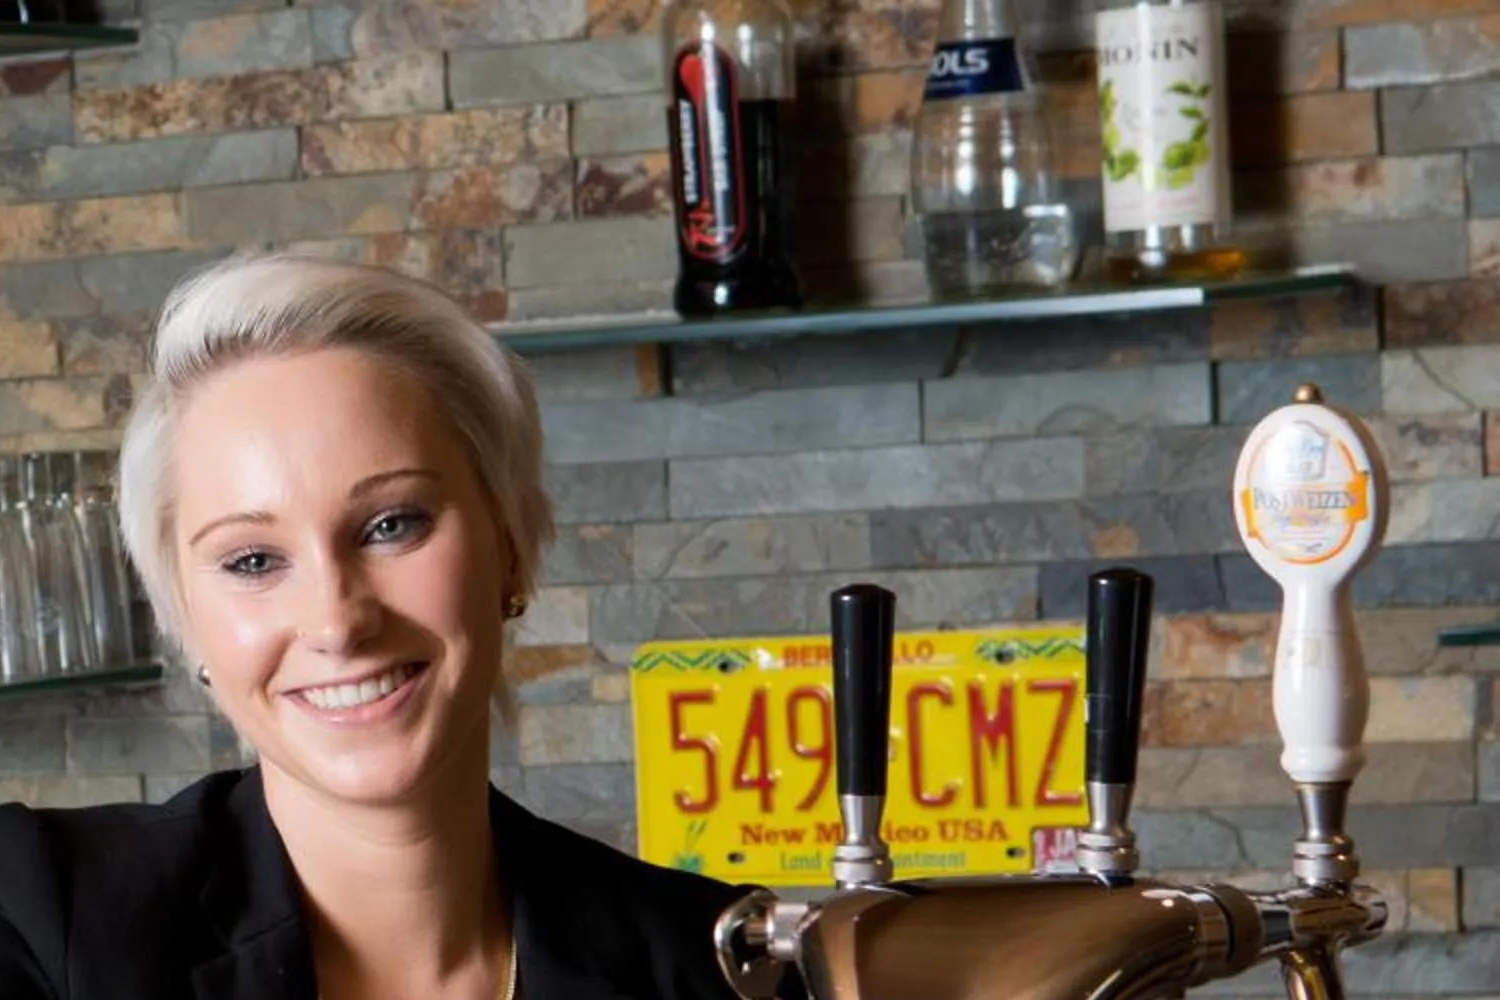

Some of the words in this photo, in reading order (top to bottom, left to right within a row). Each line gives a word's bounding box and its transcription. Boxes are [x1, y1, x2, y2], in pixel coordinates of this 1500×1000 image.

[931, 47, 989, 77] OLS
[667, 683, 832, 815] 549
[905, 679, 1085, 808] CMZ
[740, 823, 806, 846] New
[815, 820, 929, 843] Mico
[937, 819, 1010, 842] USA
[780, 851, 821, 870] Land
